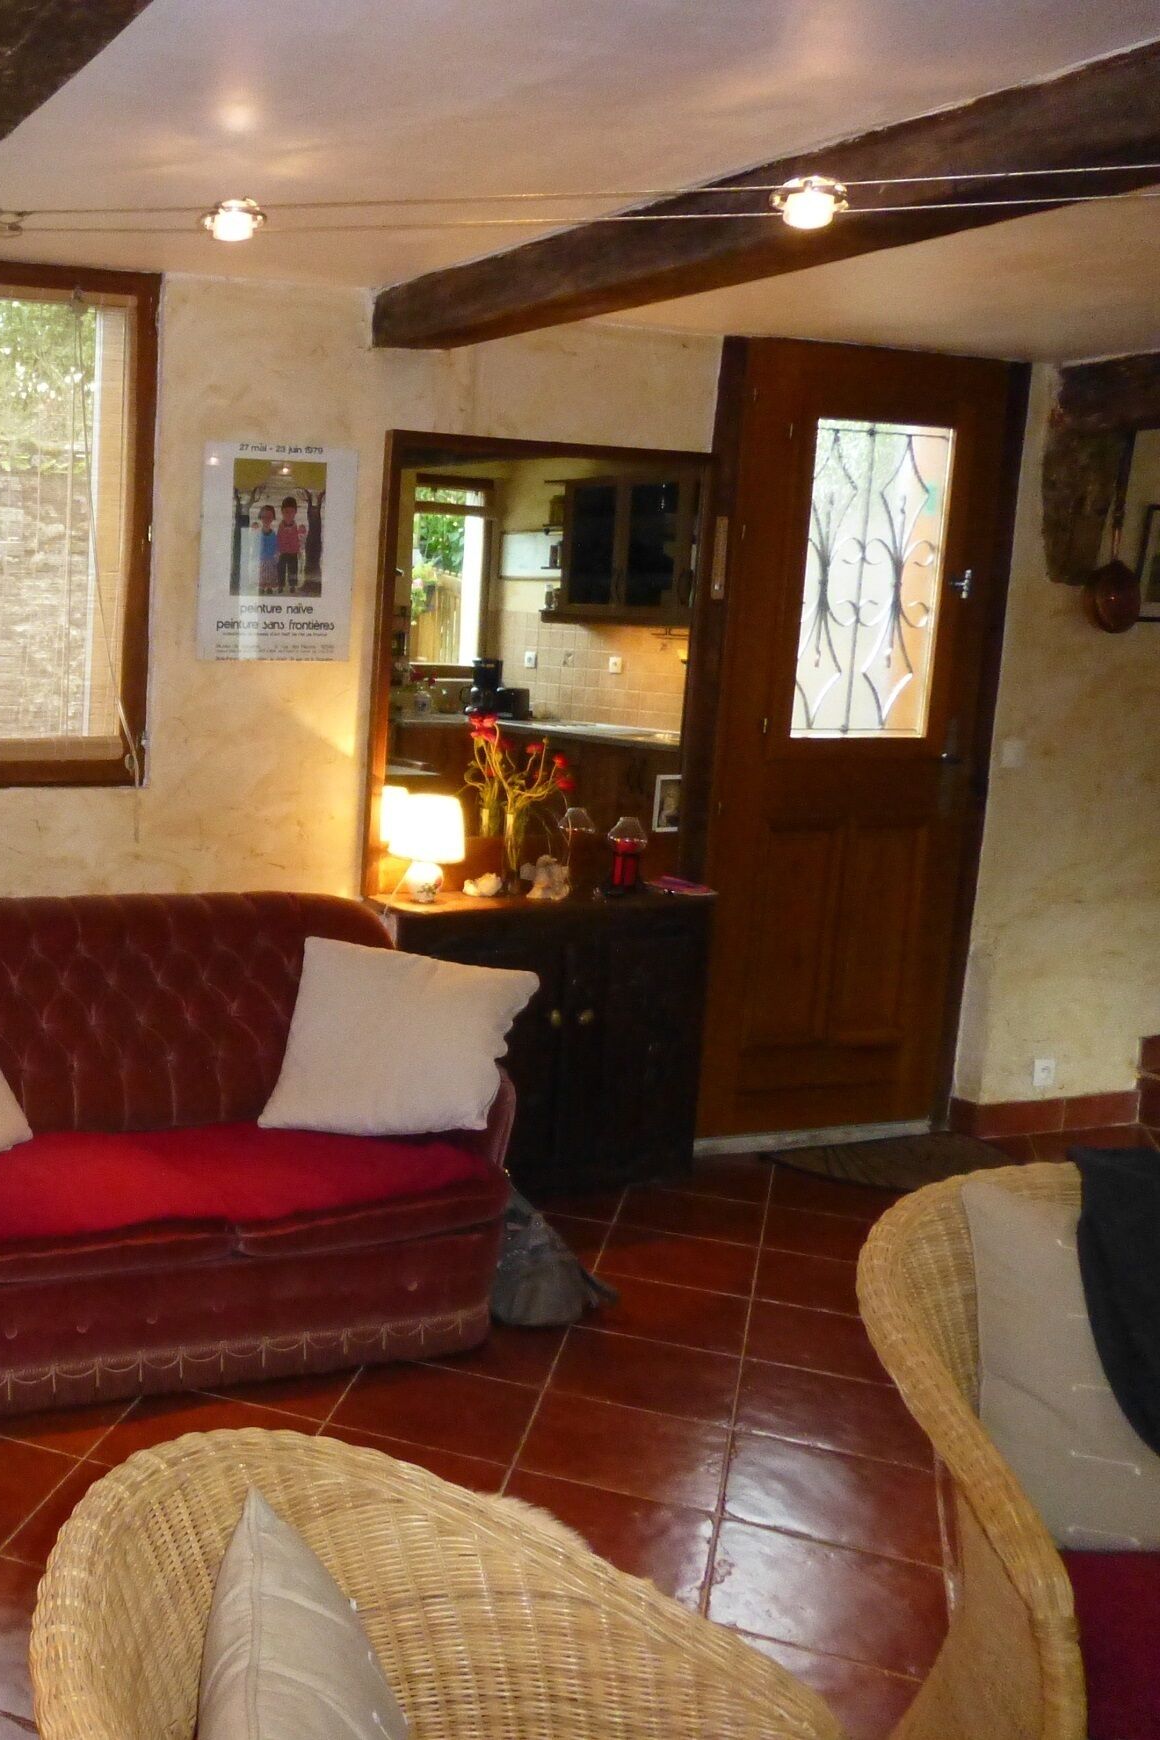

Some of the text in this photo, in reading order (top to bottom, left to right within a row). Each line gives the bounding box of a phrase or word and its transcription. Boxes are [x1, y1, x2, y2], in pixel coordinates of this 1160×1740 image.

[286, 603, 314, 614] naïve
[262, 620, 285, 630] sans
[288, 619, 335, 631] frontières
